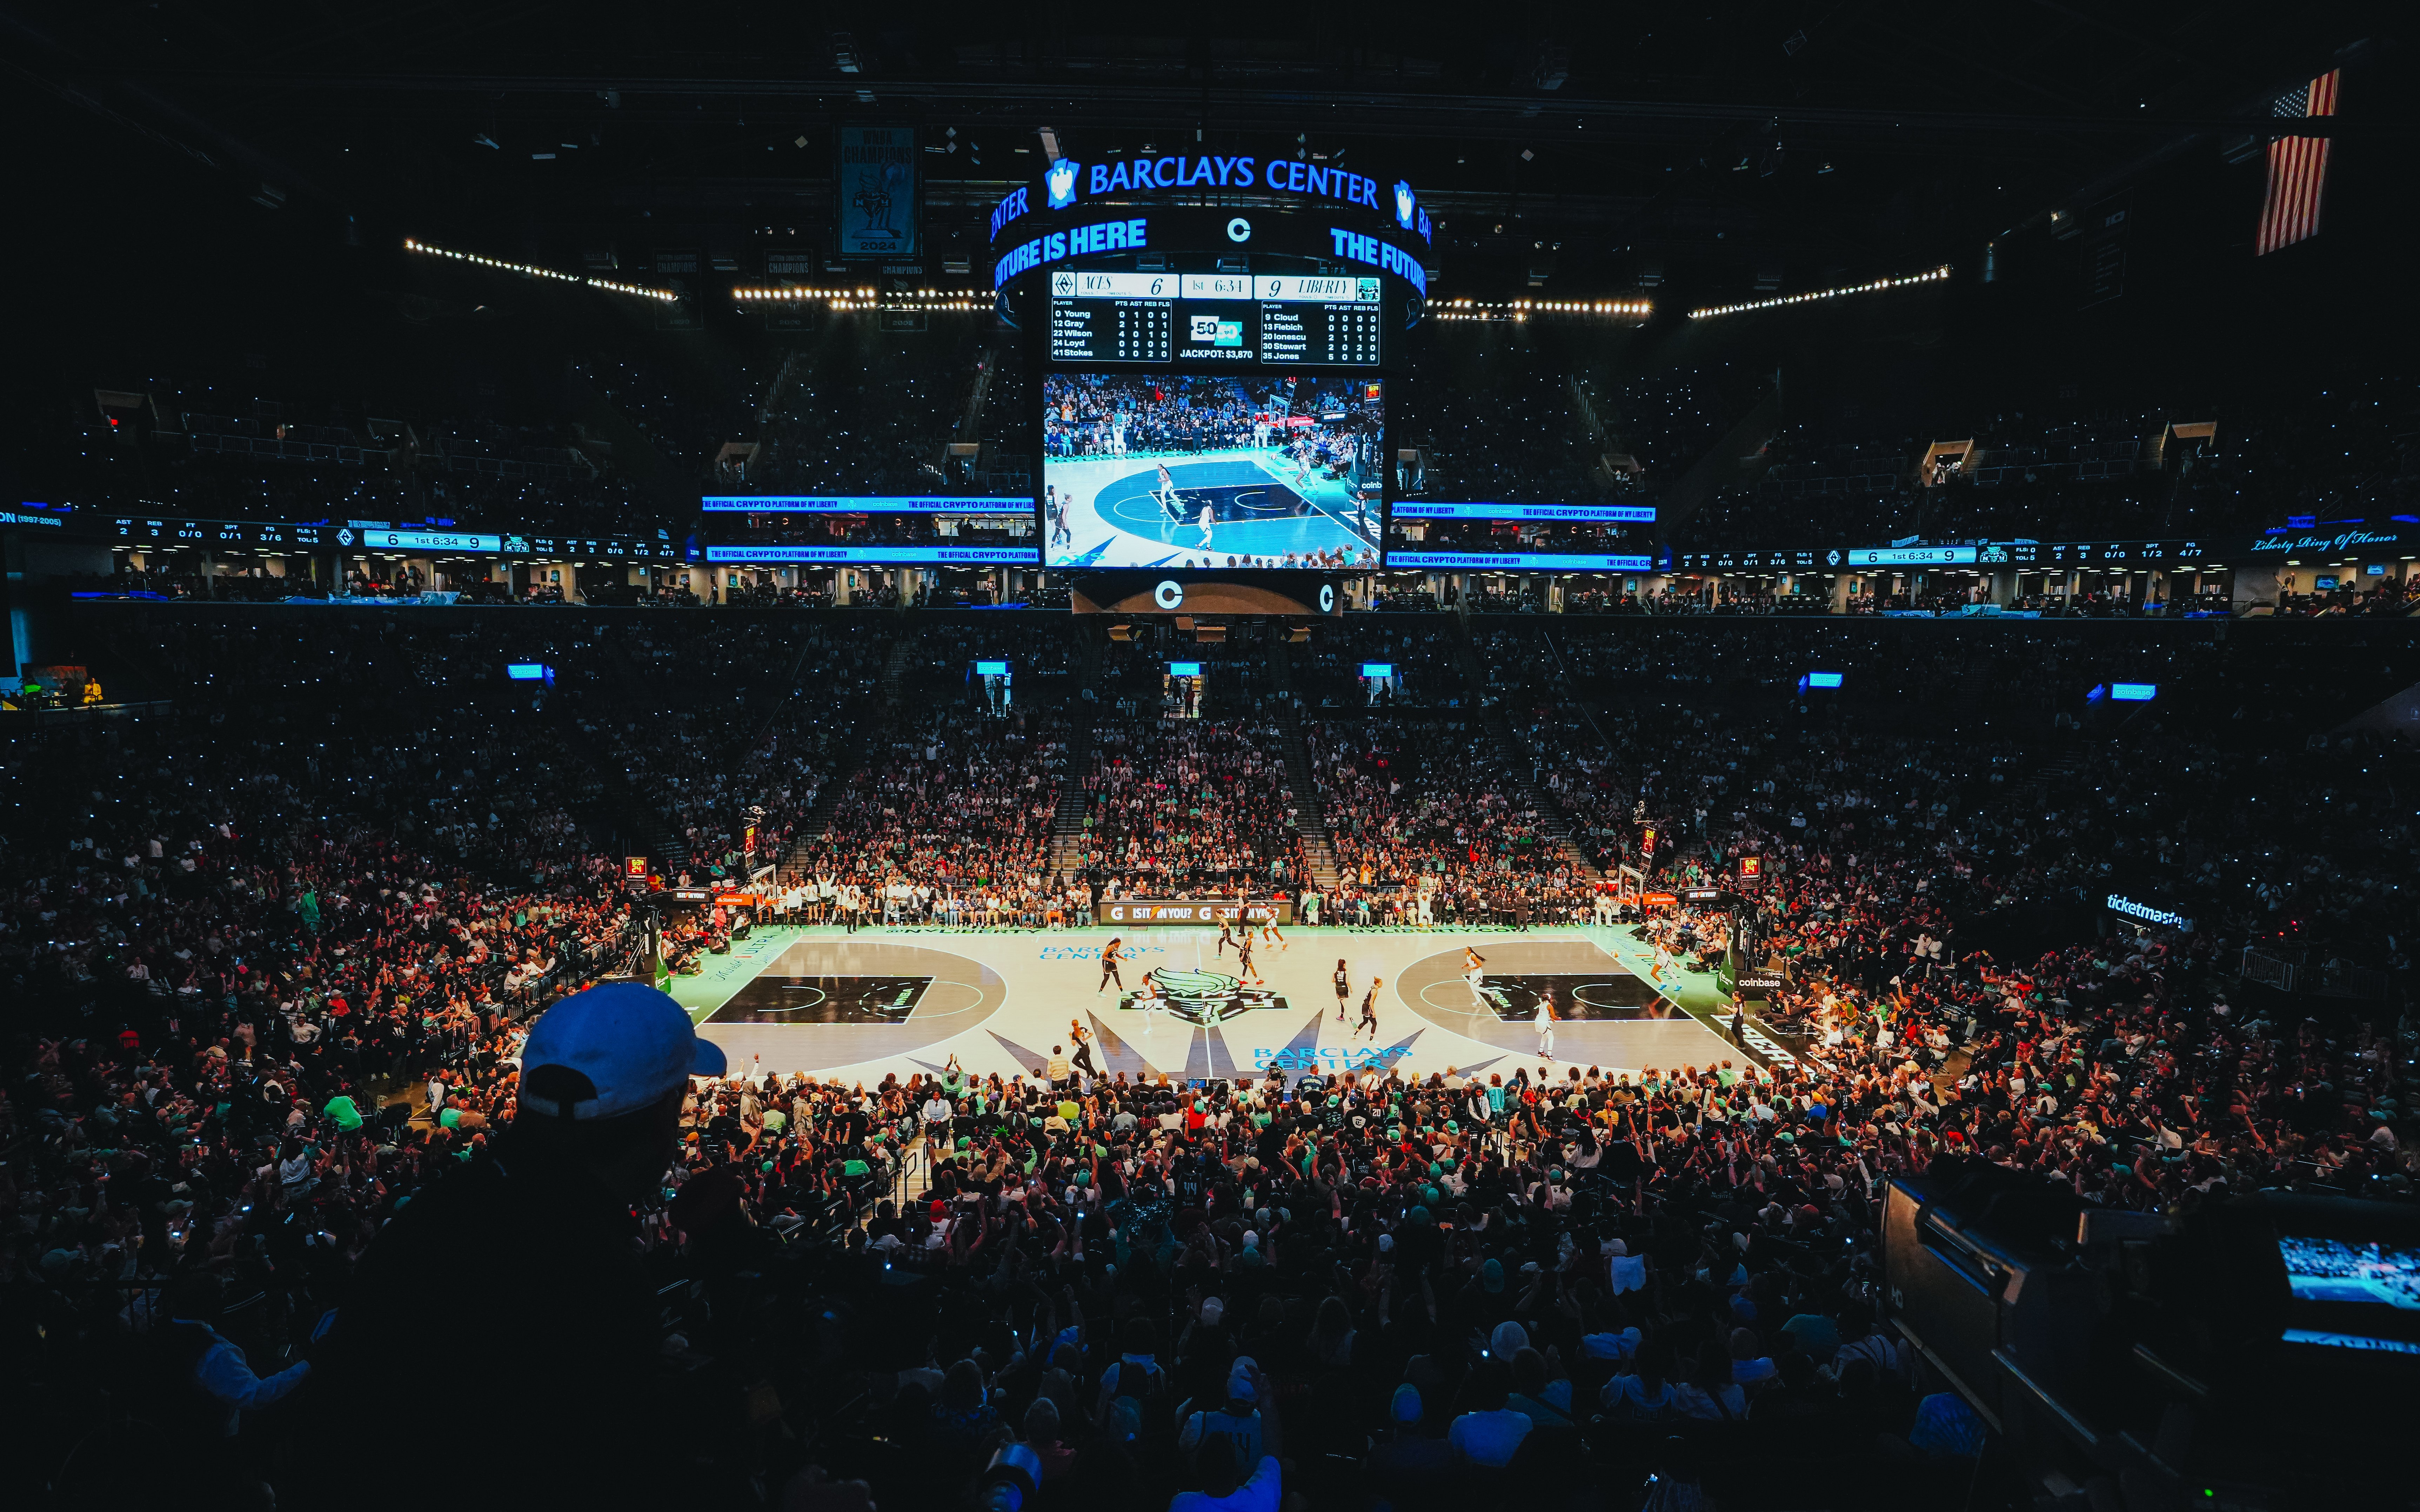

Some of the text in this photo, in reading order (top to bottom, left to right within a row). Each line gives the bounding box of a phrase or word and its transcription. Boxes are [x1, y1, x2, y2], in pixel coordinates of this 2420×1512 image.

[863, 130, 893, 145] WNBA
[844, 146, 912, 163] CHAMPIONS
[1090, 156, 1379, 210] BARCLAYS CENTER
[860, 242, 896, 250] 2024
[1043, 232, 1066, 263] IS
[1070, 219, 1147, 256] HERE
[1330, 228, 1378, 266] THE
[769, 263, 808, 273] CHAMPIONS
[883, 266, 923, 274] CHAMPIONS
[1082, 276, 1112, 290] ACES
[1151, 278, 1163, 295] 6
[1215, 280, 1242, 292] 6:34
[1269, 280, 1281, 297] 9
[1298, 280, 1350, 294] LIBERTY
[1064, 310, 1090, 318] Young
[1197, 322, 1217, 335] 50
[1226, 350, 1252, 359] $3,870
[18, 515, 61, 526] (1997-2005)
[388, 534, 399, 545] 6
[433, 537, 458, 546] 6:34
[470, 538, 479, 548] 9
[2251, 530, 2398, 553] Liberty Ring Of Honor
[1869, 552, 1877, 562] 6
[1944, 550, 1954, 561] 9
[746, 837, 754, 851] 24
[1644, 839, 1653, 852] 24
[1111, 907, 1123, 920] G
[1133, 908, 1141, 919] IS
[1142, 908, 1150, 919] IT
[1167, 908, 1192, 919] YOU?
[1199, 907, 1211, 920] G
[741, 934, 778, 954] ULTRA
[751, 948, 781, 966] Courtside
[709, 959, 745, 982] Michelob
[1739, 978, 1780, 987] coinbase
[892, 988, 914, 1006] WNBA
[1254, 1047, 1413, 1057] BARCLAYS
[1255, 1059, 1390, 1070] CENTER
[1372, 1109, 1381, 1117] 20
